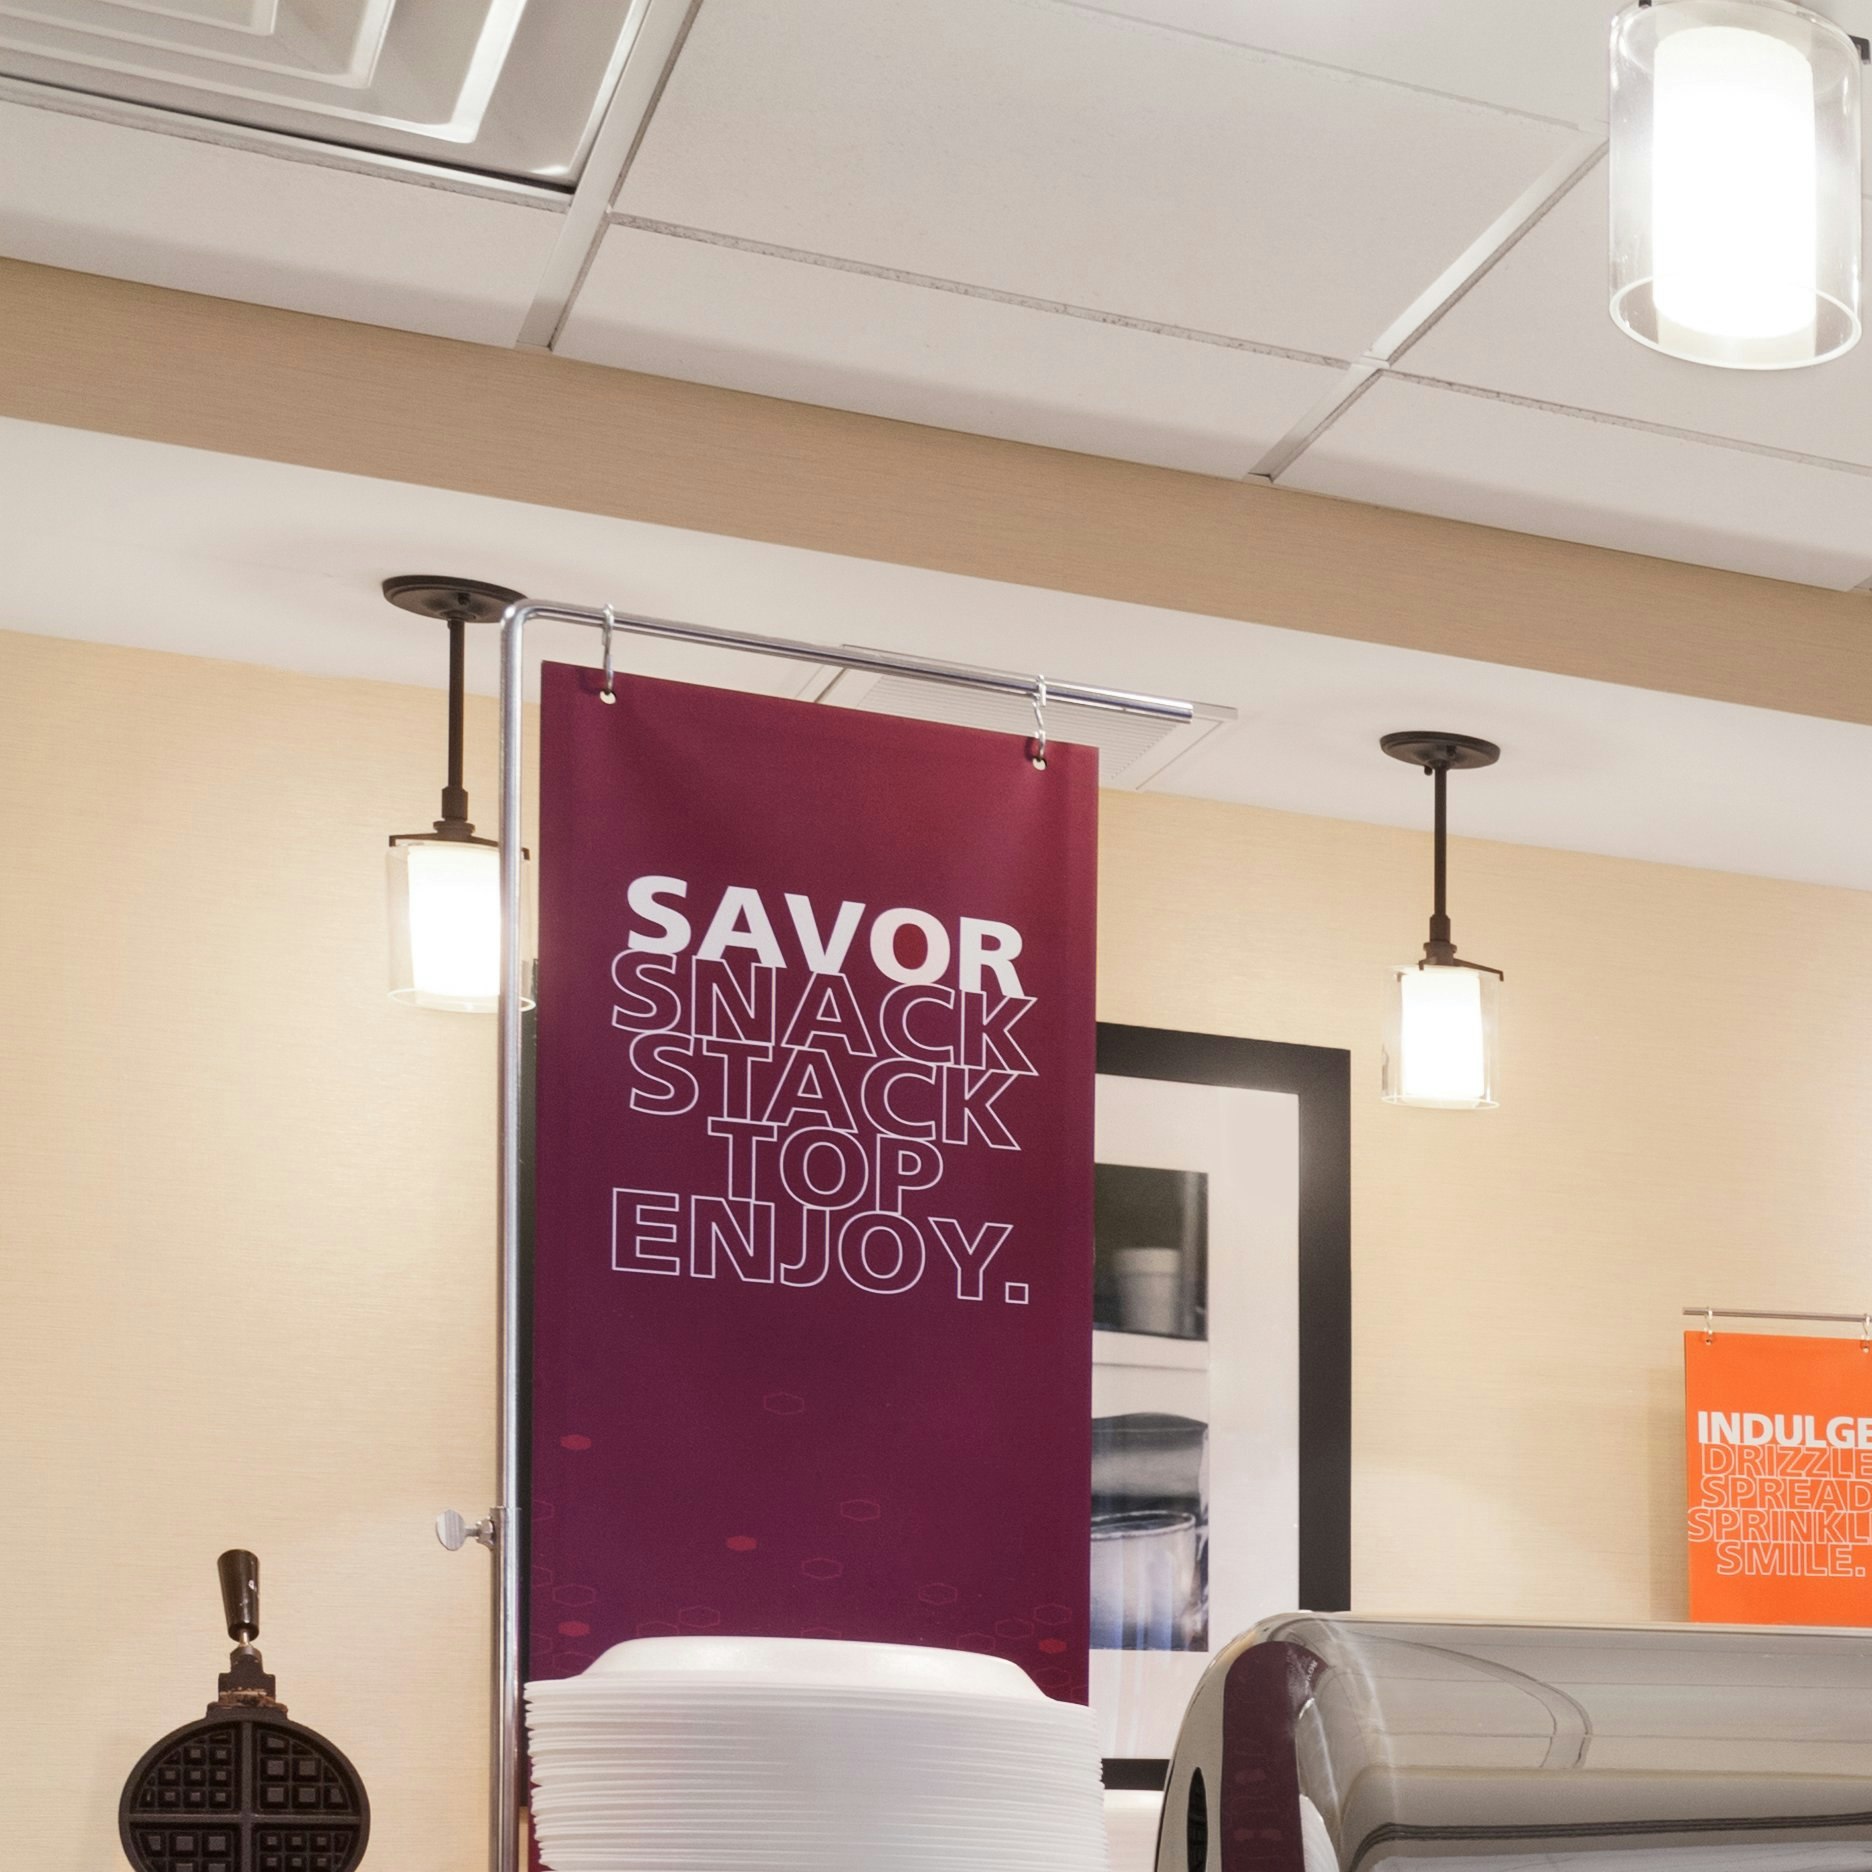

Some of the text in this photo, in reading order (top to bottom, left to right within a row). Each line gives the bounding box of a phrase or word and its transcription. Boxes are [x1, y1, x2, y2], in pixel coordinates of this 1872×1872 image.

[626, 876, 1023, 996] SAVOR
[611, 950, 1037, 1075] SNACK
[629, 1031, 1020, 1149] STACK
[707, 1117, 943, 1214] TOP
[611, 1187, 1029, 1304] ENJOY.
[1717, 1541, 1866, 1577] SMILE.
